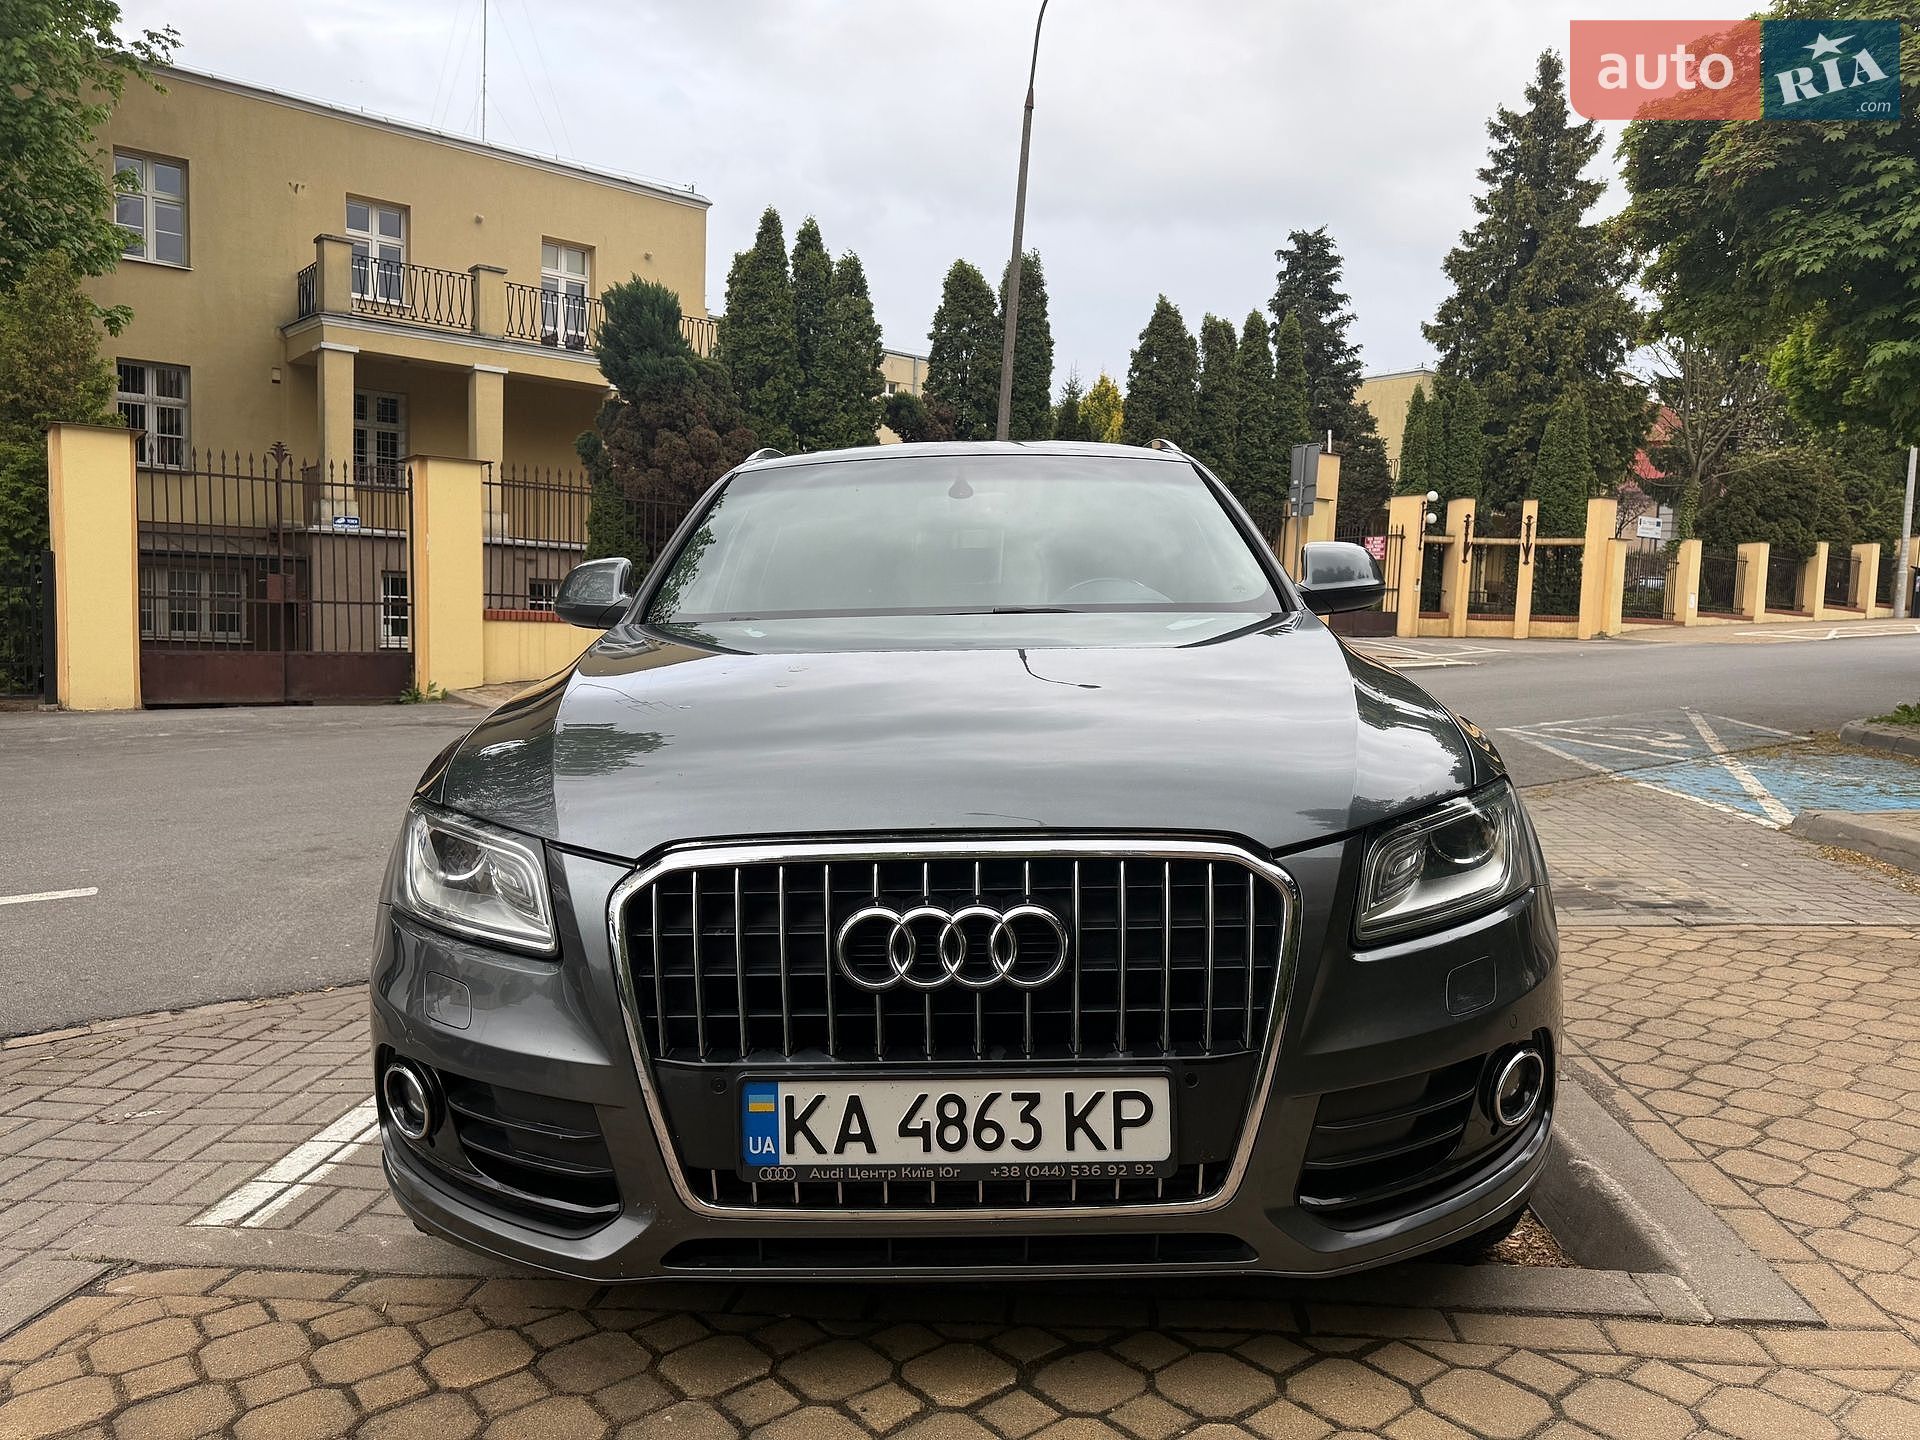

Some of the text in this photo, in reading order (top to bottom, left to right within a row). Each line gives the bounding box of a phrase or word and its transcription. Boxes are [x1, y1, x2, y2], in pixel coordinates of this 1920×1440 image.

[784, 1090, 1154, 1155] KA 4863 KP
[749, 1137, 775, 1154] UA
[809, 1166, 961, 1181] Audi Центр Київ Юг
[990, 1164, 1155, 1178] +38 (044) 536 92 92
